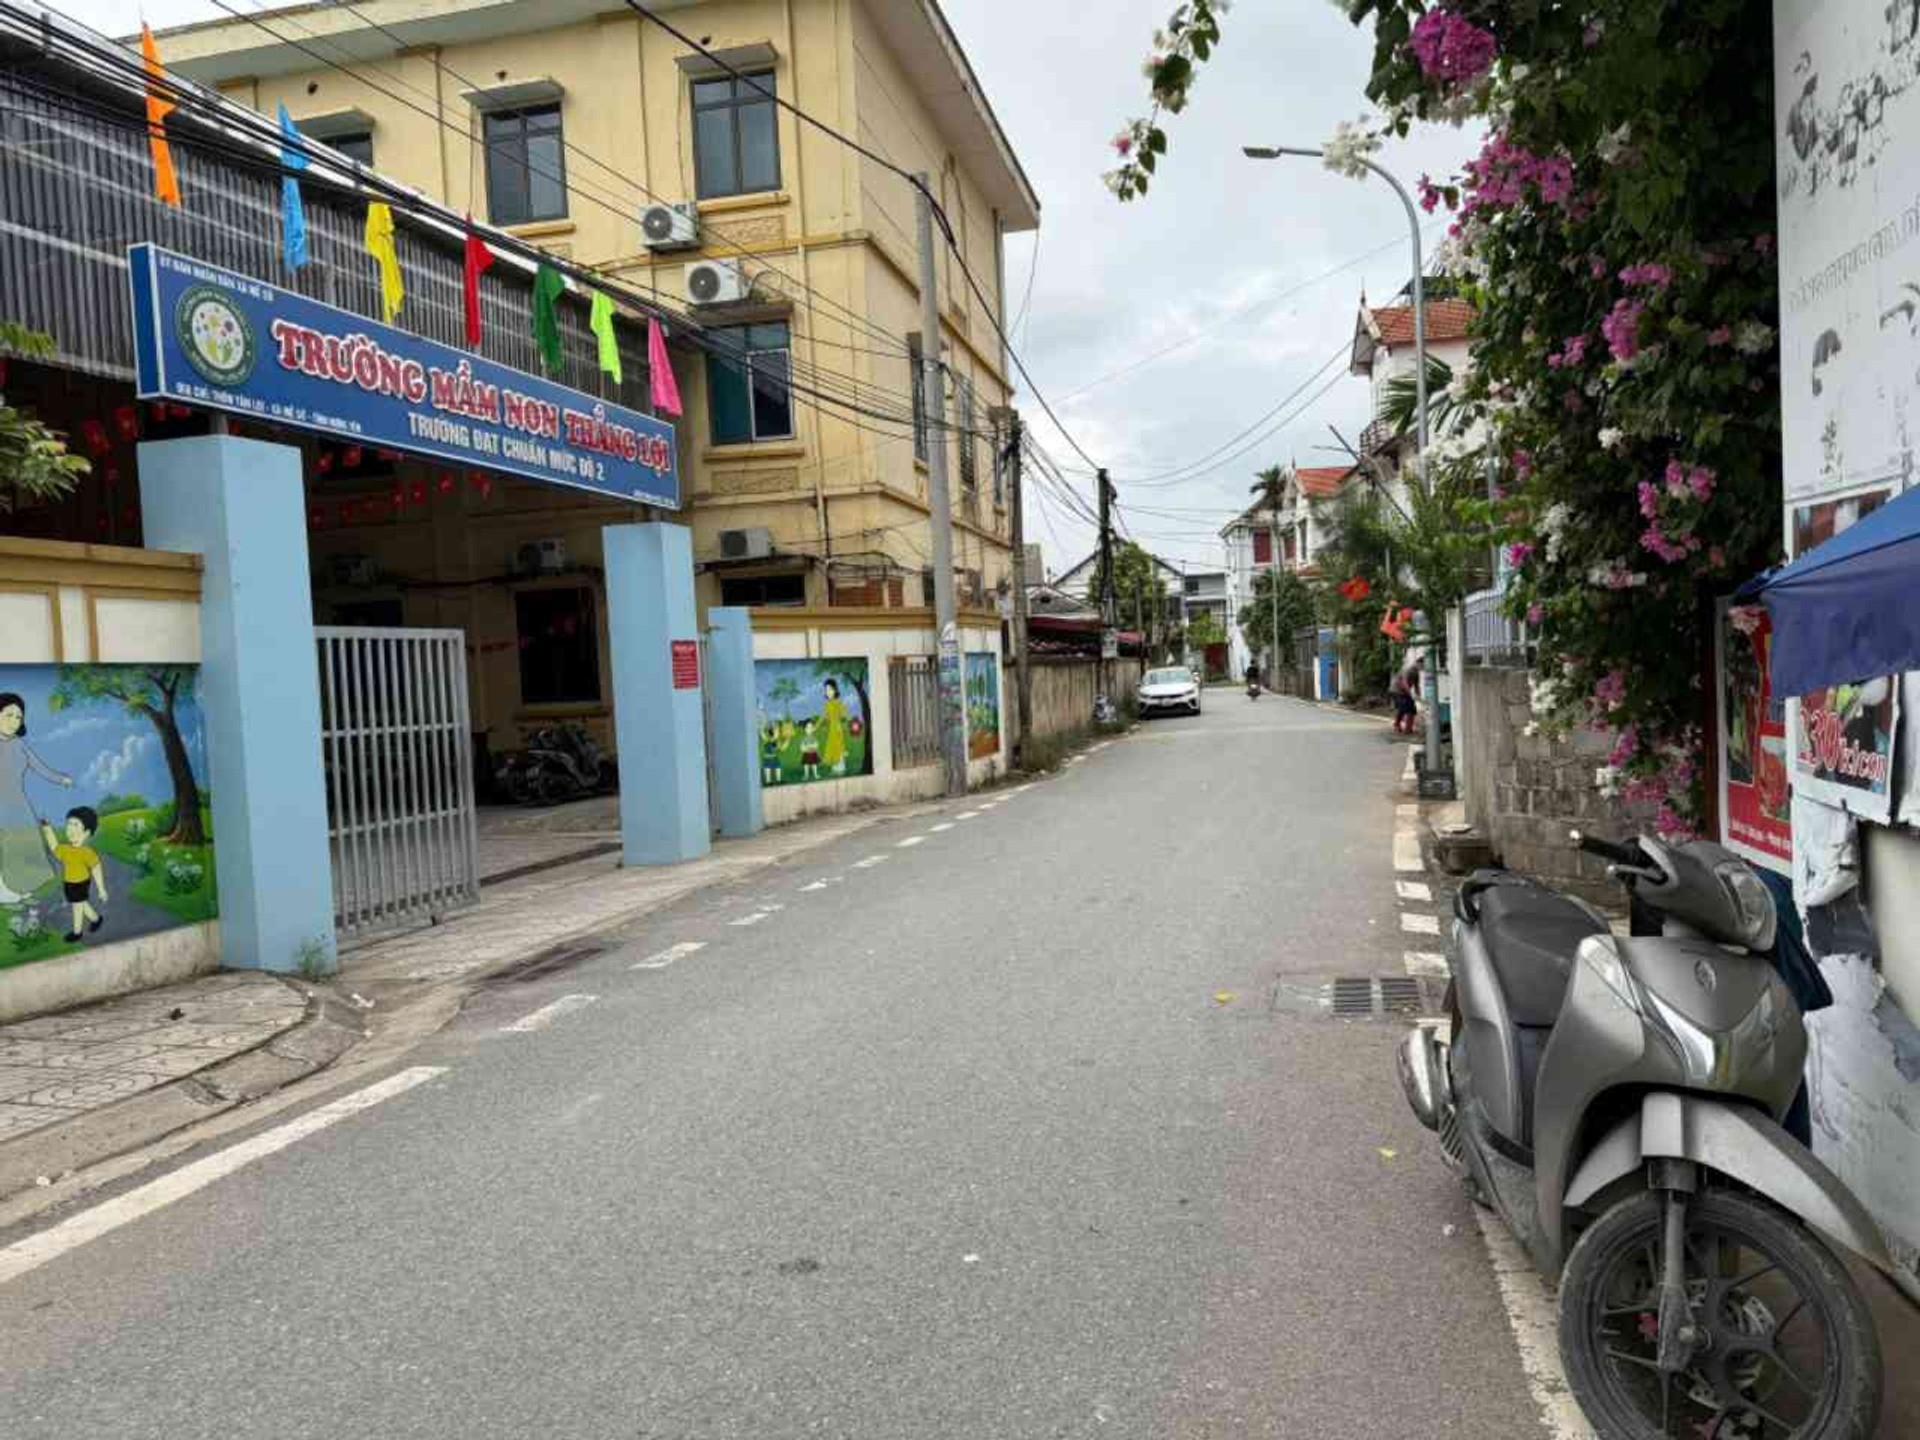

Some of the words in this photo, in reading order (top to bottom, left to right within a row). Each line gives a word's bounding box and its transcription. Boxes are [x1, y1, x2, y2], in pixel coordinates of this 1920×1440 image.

[271, 318, 427, 403] TRƯỜNG
[428, 359, 500, 424] MẦM
[502, 389, 560, 439] NON
[563, 403, 637, 462] THẮNG
[637, 433, 672, 478] LỢI
[408, 411, 470, 448] TRƯỜNG
[473, 427, 499, 459] ĐẠT
[502, 436, 548, 467] CHUẨN
[549, 450, 577, 475] MỨC
[579, 456, 595, 480] ĐỘ
[596, 463, 605, 481] 2
